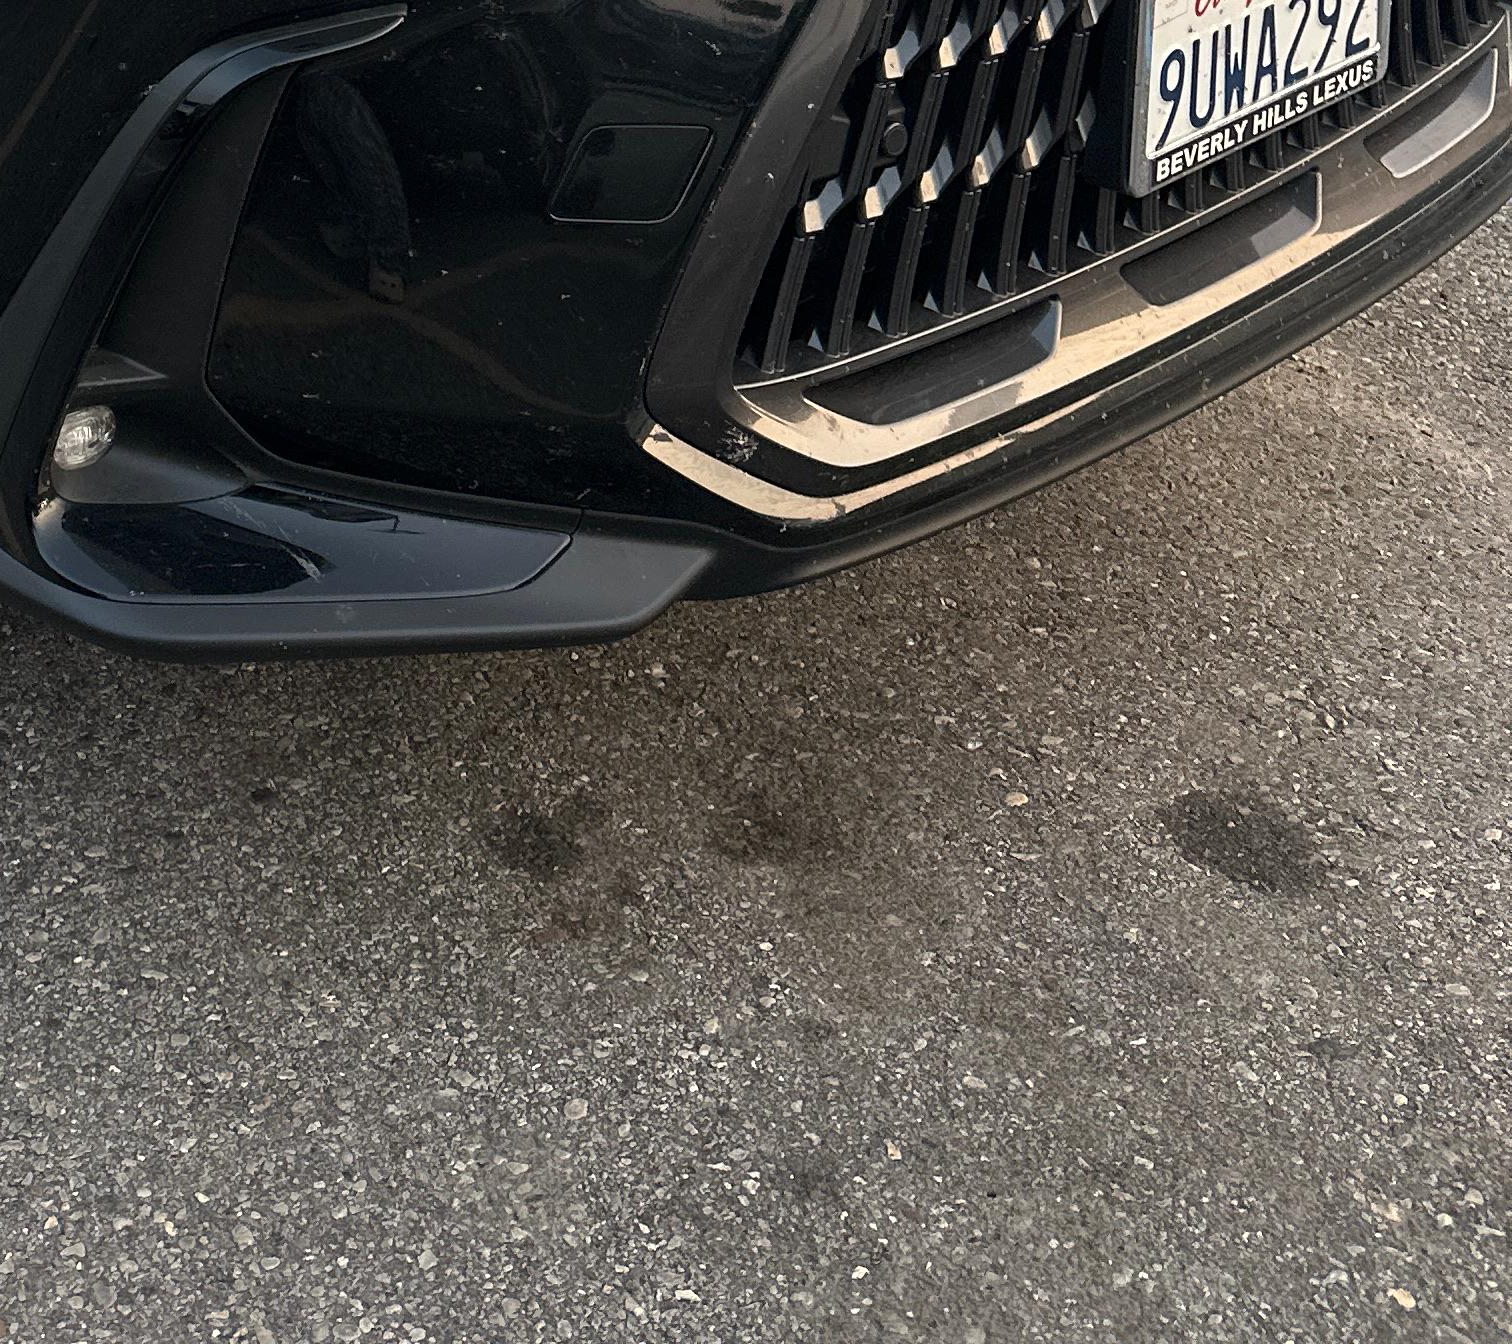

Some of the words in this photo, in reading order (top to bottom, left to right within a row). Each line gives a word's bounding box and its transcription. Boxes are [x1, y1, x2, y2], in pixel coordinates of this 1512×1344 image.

[1156, 119, 1248, 182] BEVERLY
[1252, 90, 1309, 133] HILLS
[1313, 59, 1374, 105] LEXUS
